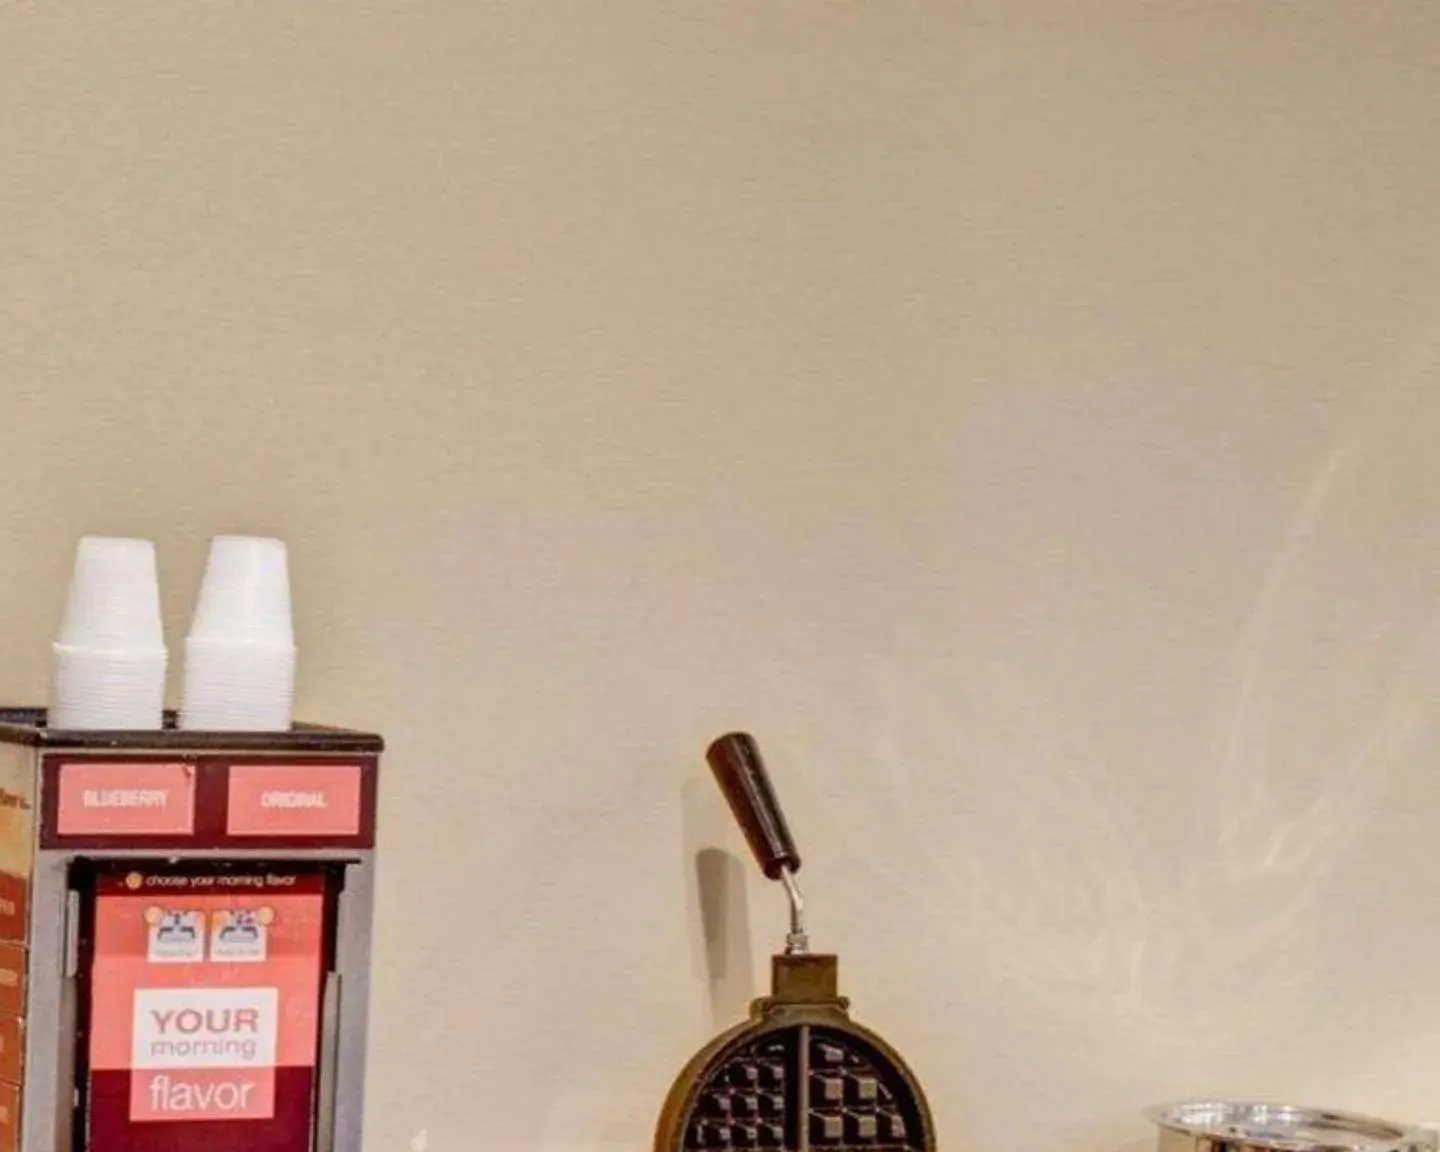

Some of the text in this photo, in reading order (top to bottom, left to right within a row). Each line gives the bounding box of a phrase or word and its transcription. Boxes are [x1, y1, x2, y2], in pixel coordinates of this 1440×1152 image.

[83, 789, 168, 808] BLUEBERRY
[261, 791, 327, 808] ORIGINAL
[146, 873, 296, 888] choose your morning flavor
[150, 1008, 259, 1034] YOUR
[150, 1038, 257, 1060] morning
[148, 1074, 256, 1112] flavor
